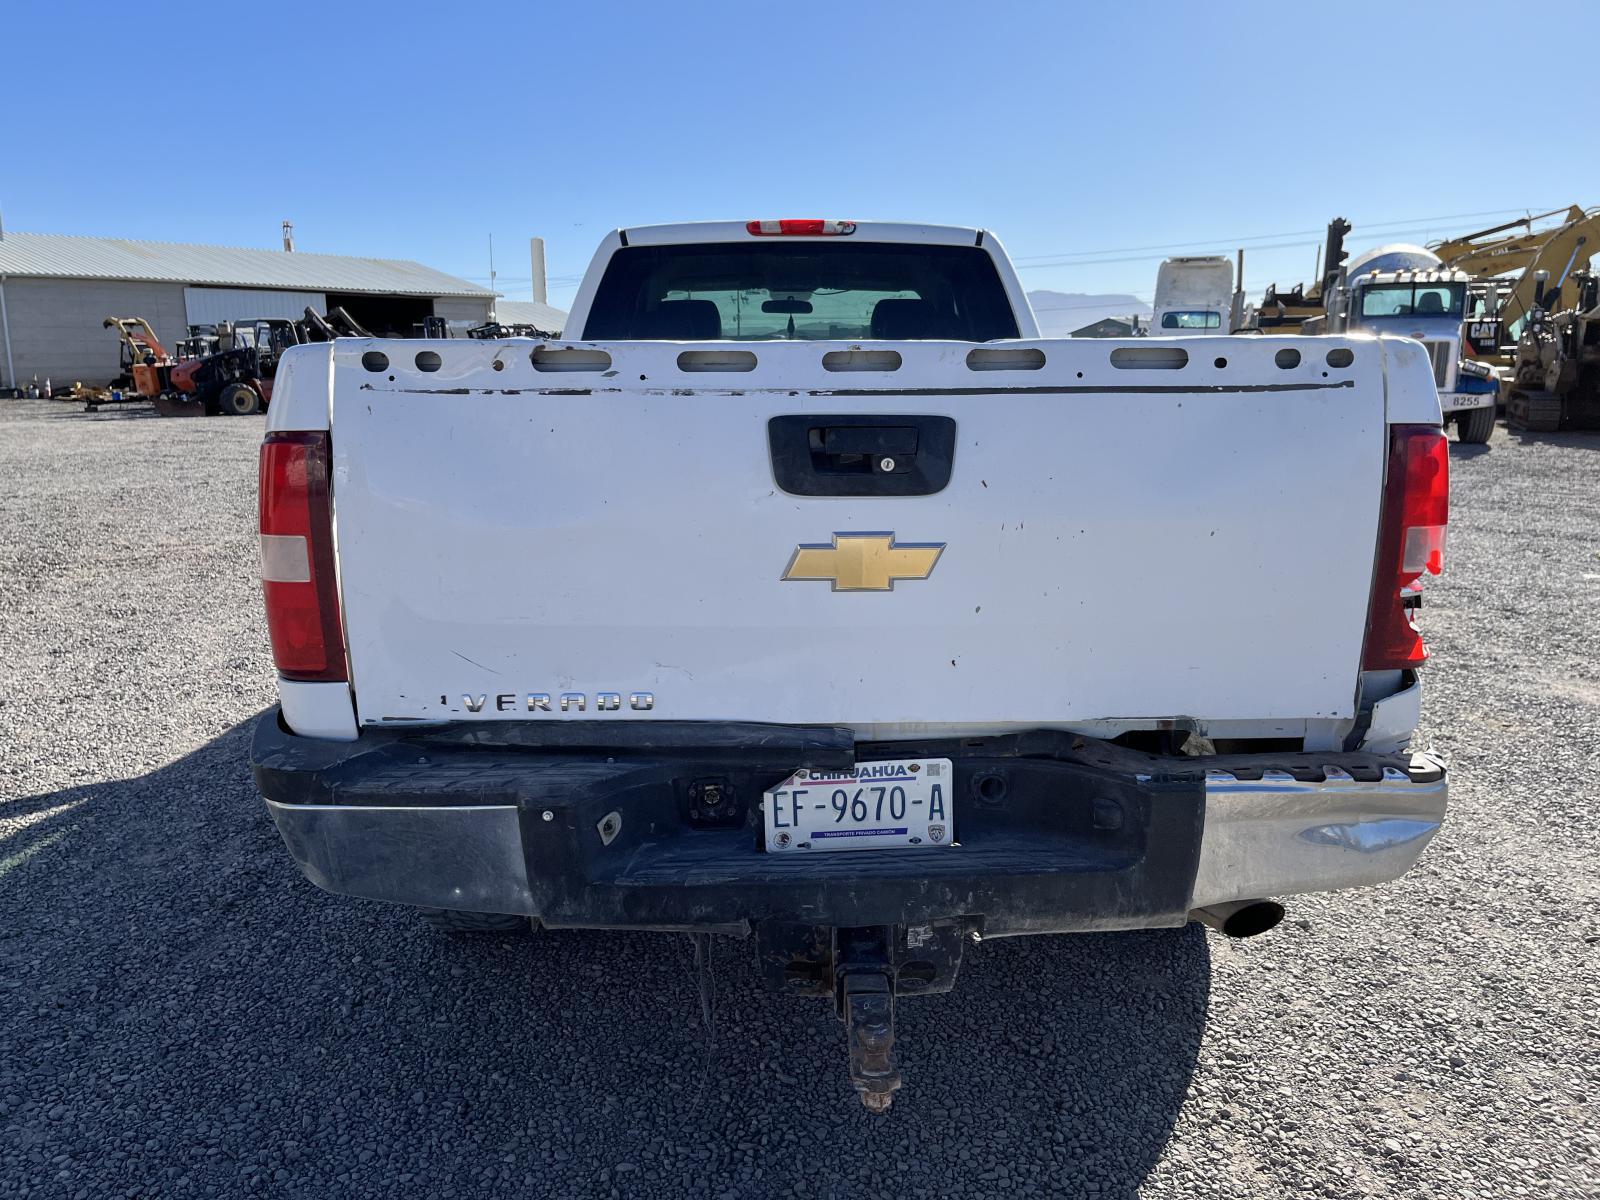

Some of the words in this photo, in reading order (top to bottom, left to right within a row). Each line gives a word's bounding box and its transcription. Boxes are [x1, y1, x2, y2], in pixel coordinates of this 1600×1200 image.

[1471, 322, 1497, 338] CAT
[1453, 397, 1480, 407] 8255
[773, 783, 945, 828] EF-9670-A
